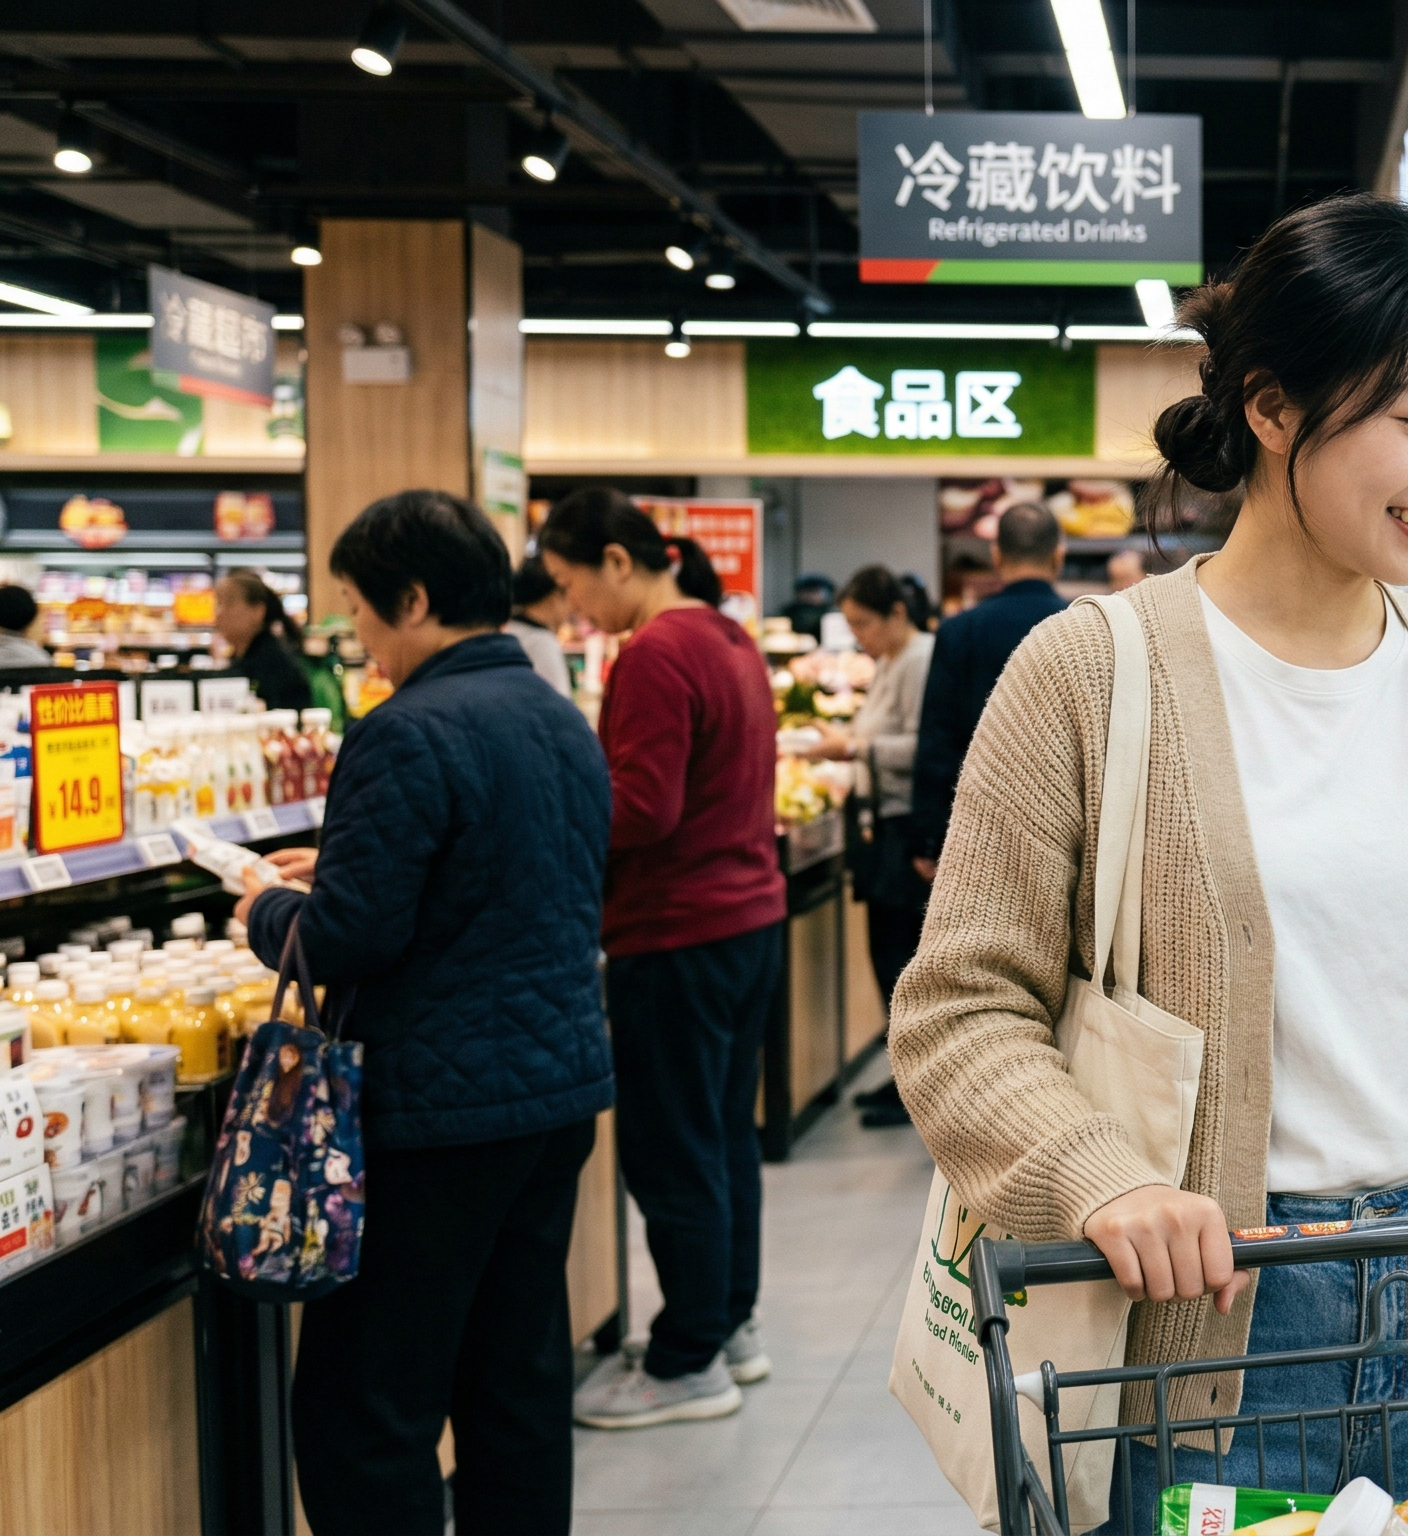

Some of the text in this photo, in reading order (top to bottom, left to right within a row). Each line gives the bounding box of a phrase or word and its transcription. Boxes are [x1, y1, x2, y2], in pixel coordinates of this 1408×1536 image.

[895, 140, 1182, 214] 冷藏饮料
[928, 216, 1147, 248] Refrigerated Drinks
[812, 365, 1023, 440] 食品区
